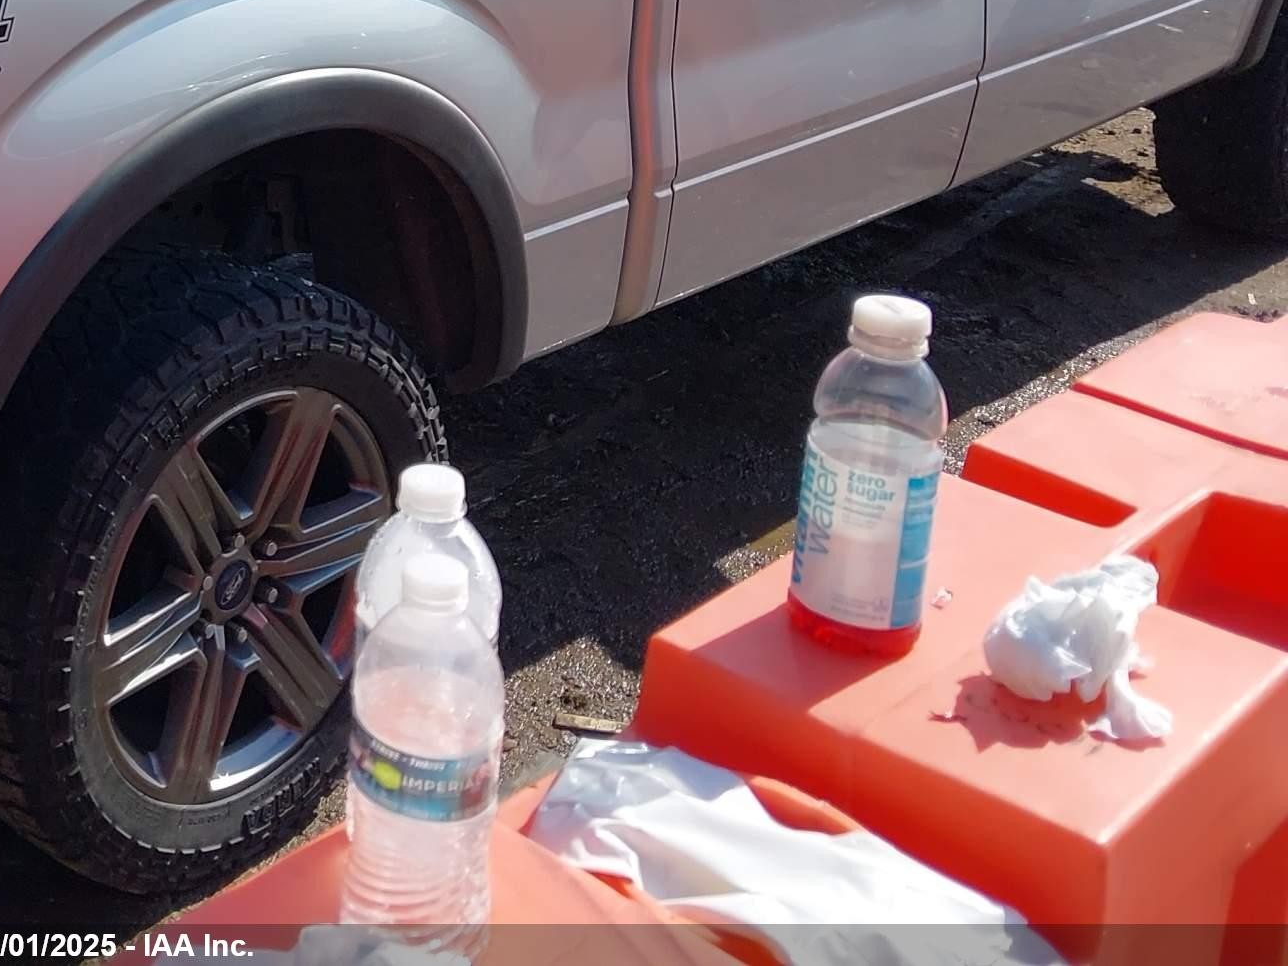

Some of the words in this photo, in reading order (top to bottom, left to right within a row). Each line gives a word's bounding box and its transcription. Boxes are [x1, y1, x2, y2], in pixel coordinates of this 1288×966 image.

[847, 471, 887, 489] zero
[845, 482, 896, 502] sugar
[808, 455, 839, 555] water
